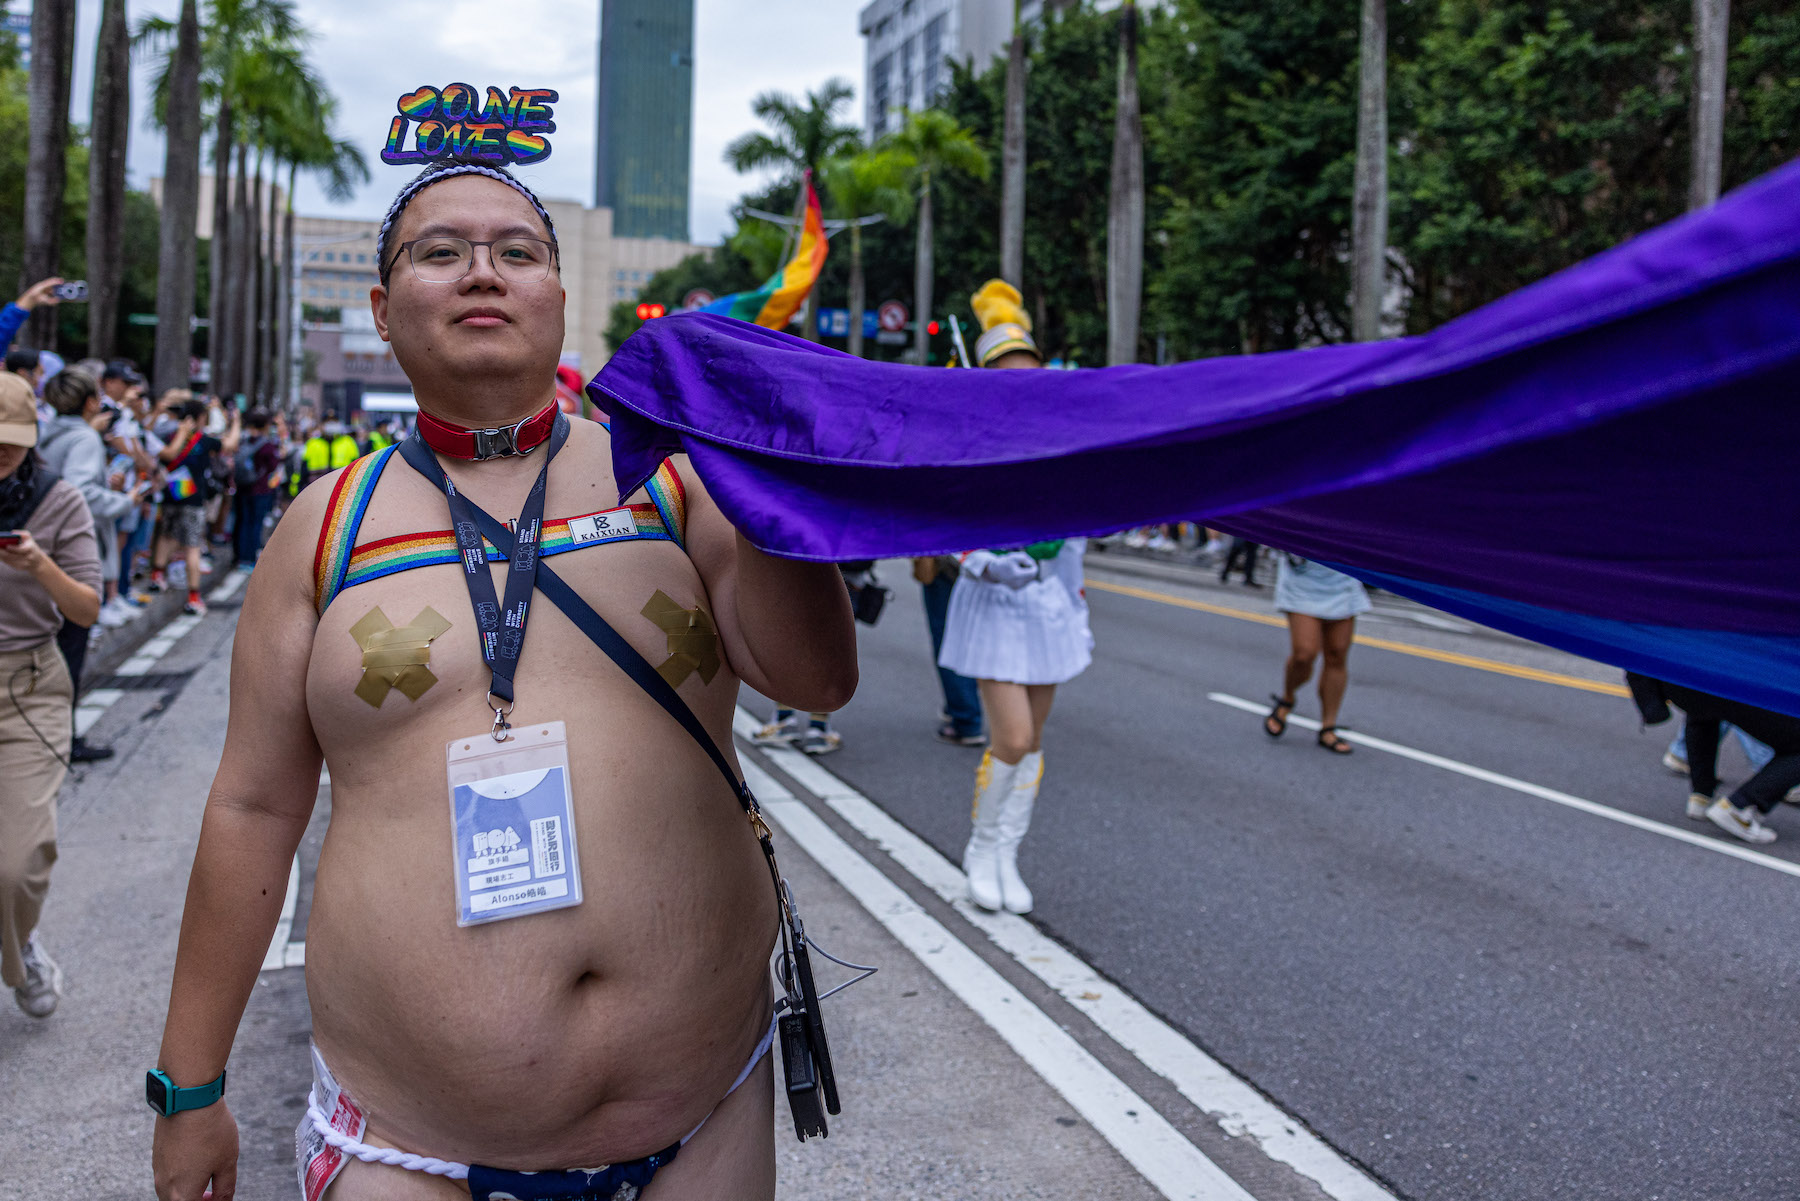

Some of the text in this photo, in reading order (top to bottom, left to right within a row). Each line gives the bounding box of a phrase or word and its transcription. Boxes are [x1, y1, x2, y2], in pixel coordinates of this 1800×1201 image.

[441, 84, 552, 127] ONE
[381, 118, 506, 159] LOVE
[580, 527, 630, 541] KAIXUAN
[505, 609, 513, 626] STAND
[515, 601, 524, 628] DIVERSITY
[486, 632, 496, 661] DIVERSITY
